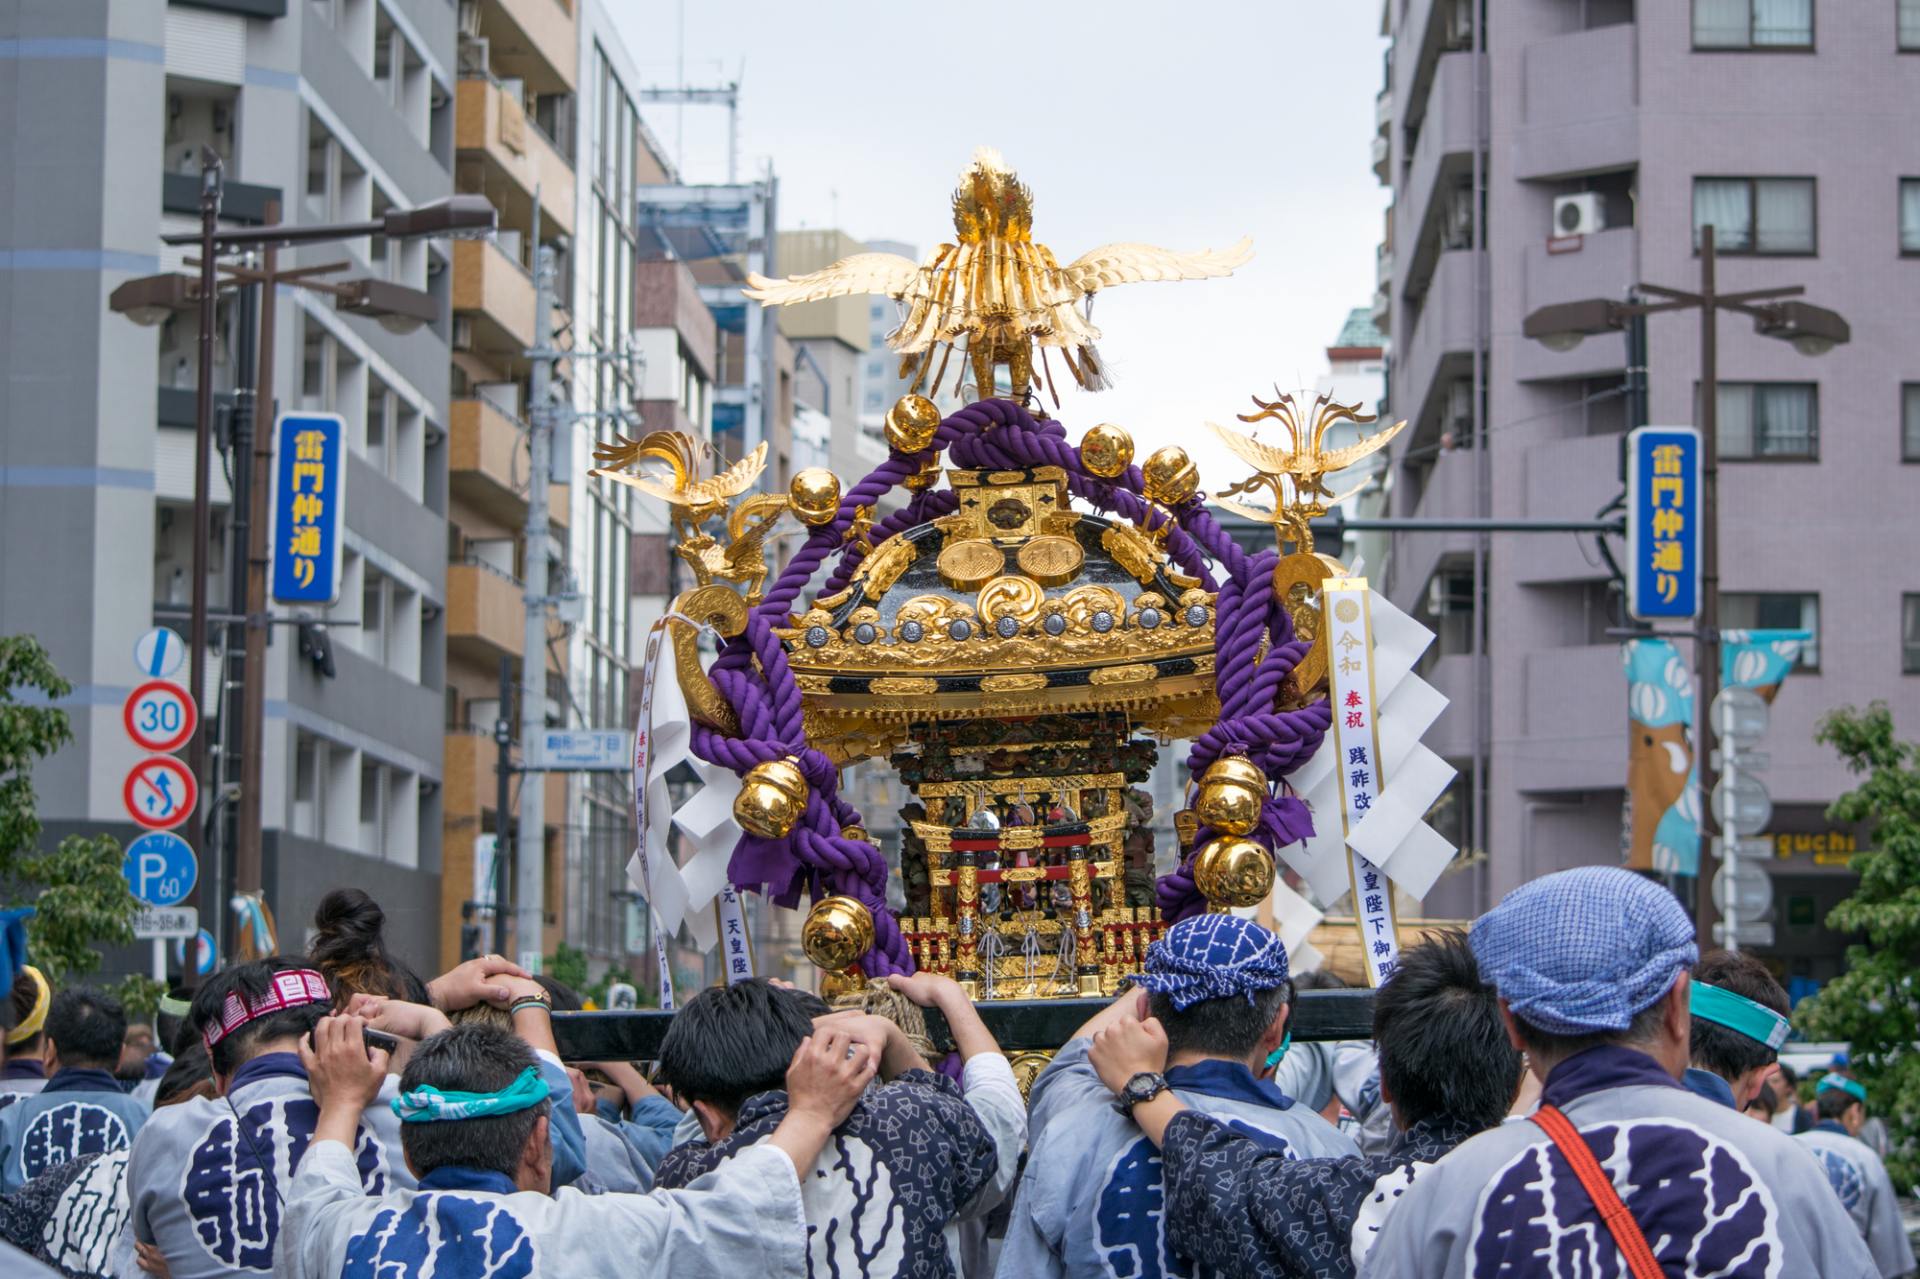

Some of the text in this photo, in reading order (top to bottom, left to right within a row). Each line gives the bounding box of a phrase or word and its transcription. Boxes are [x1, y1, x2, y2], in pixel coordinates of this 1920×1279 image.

[289, 430, 327, 589] 雷門仲通り
[1651, 444, 1684, 604] 雷門仲通り
[1336, 629, 1363, 676] 令和
[140, 700, 181, 733] 30
[1343, 689, 1365, 729] 奉祝
[1348, 746, 1372, 822] 践祚改
[1763, 832, 1857, 860] guchi
[140, 853, 167, 899] P
[160, 878, 180, 898] 60
[727, 918, 750, 983] 天皇陛
